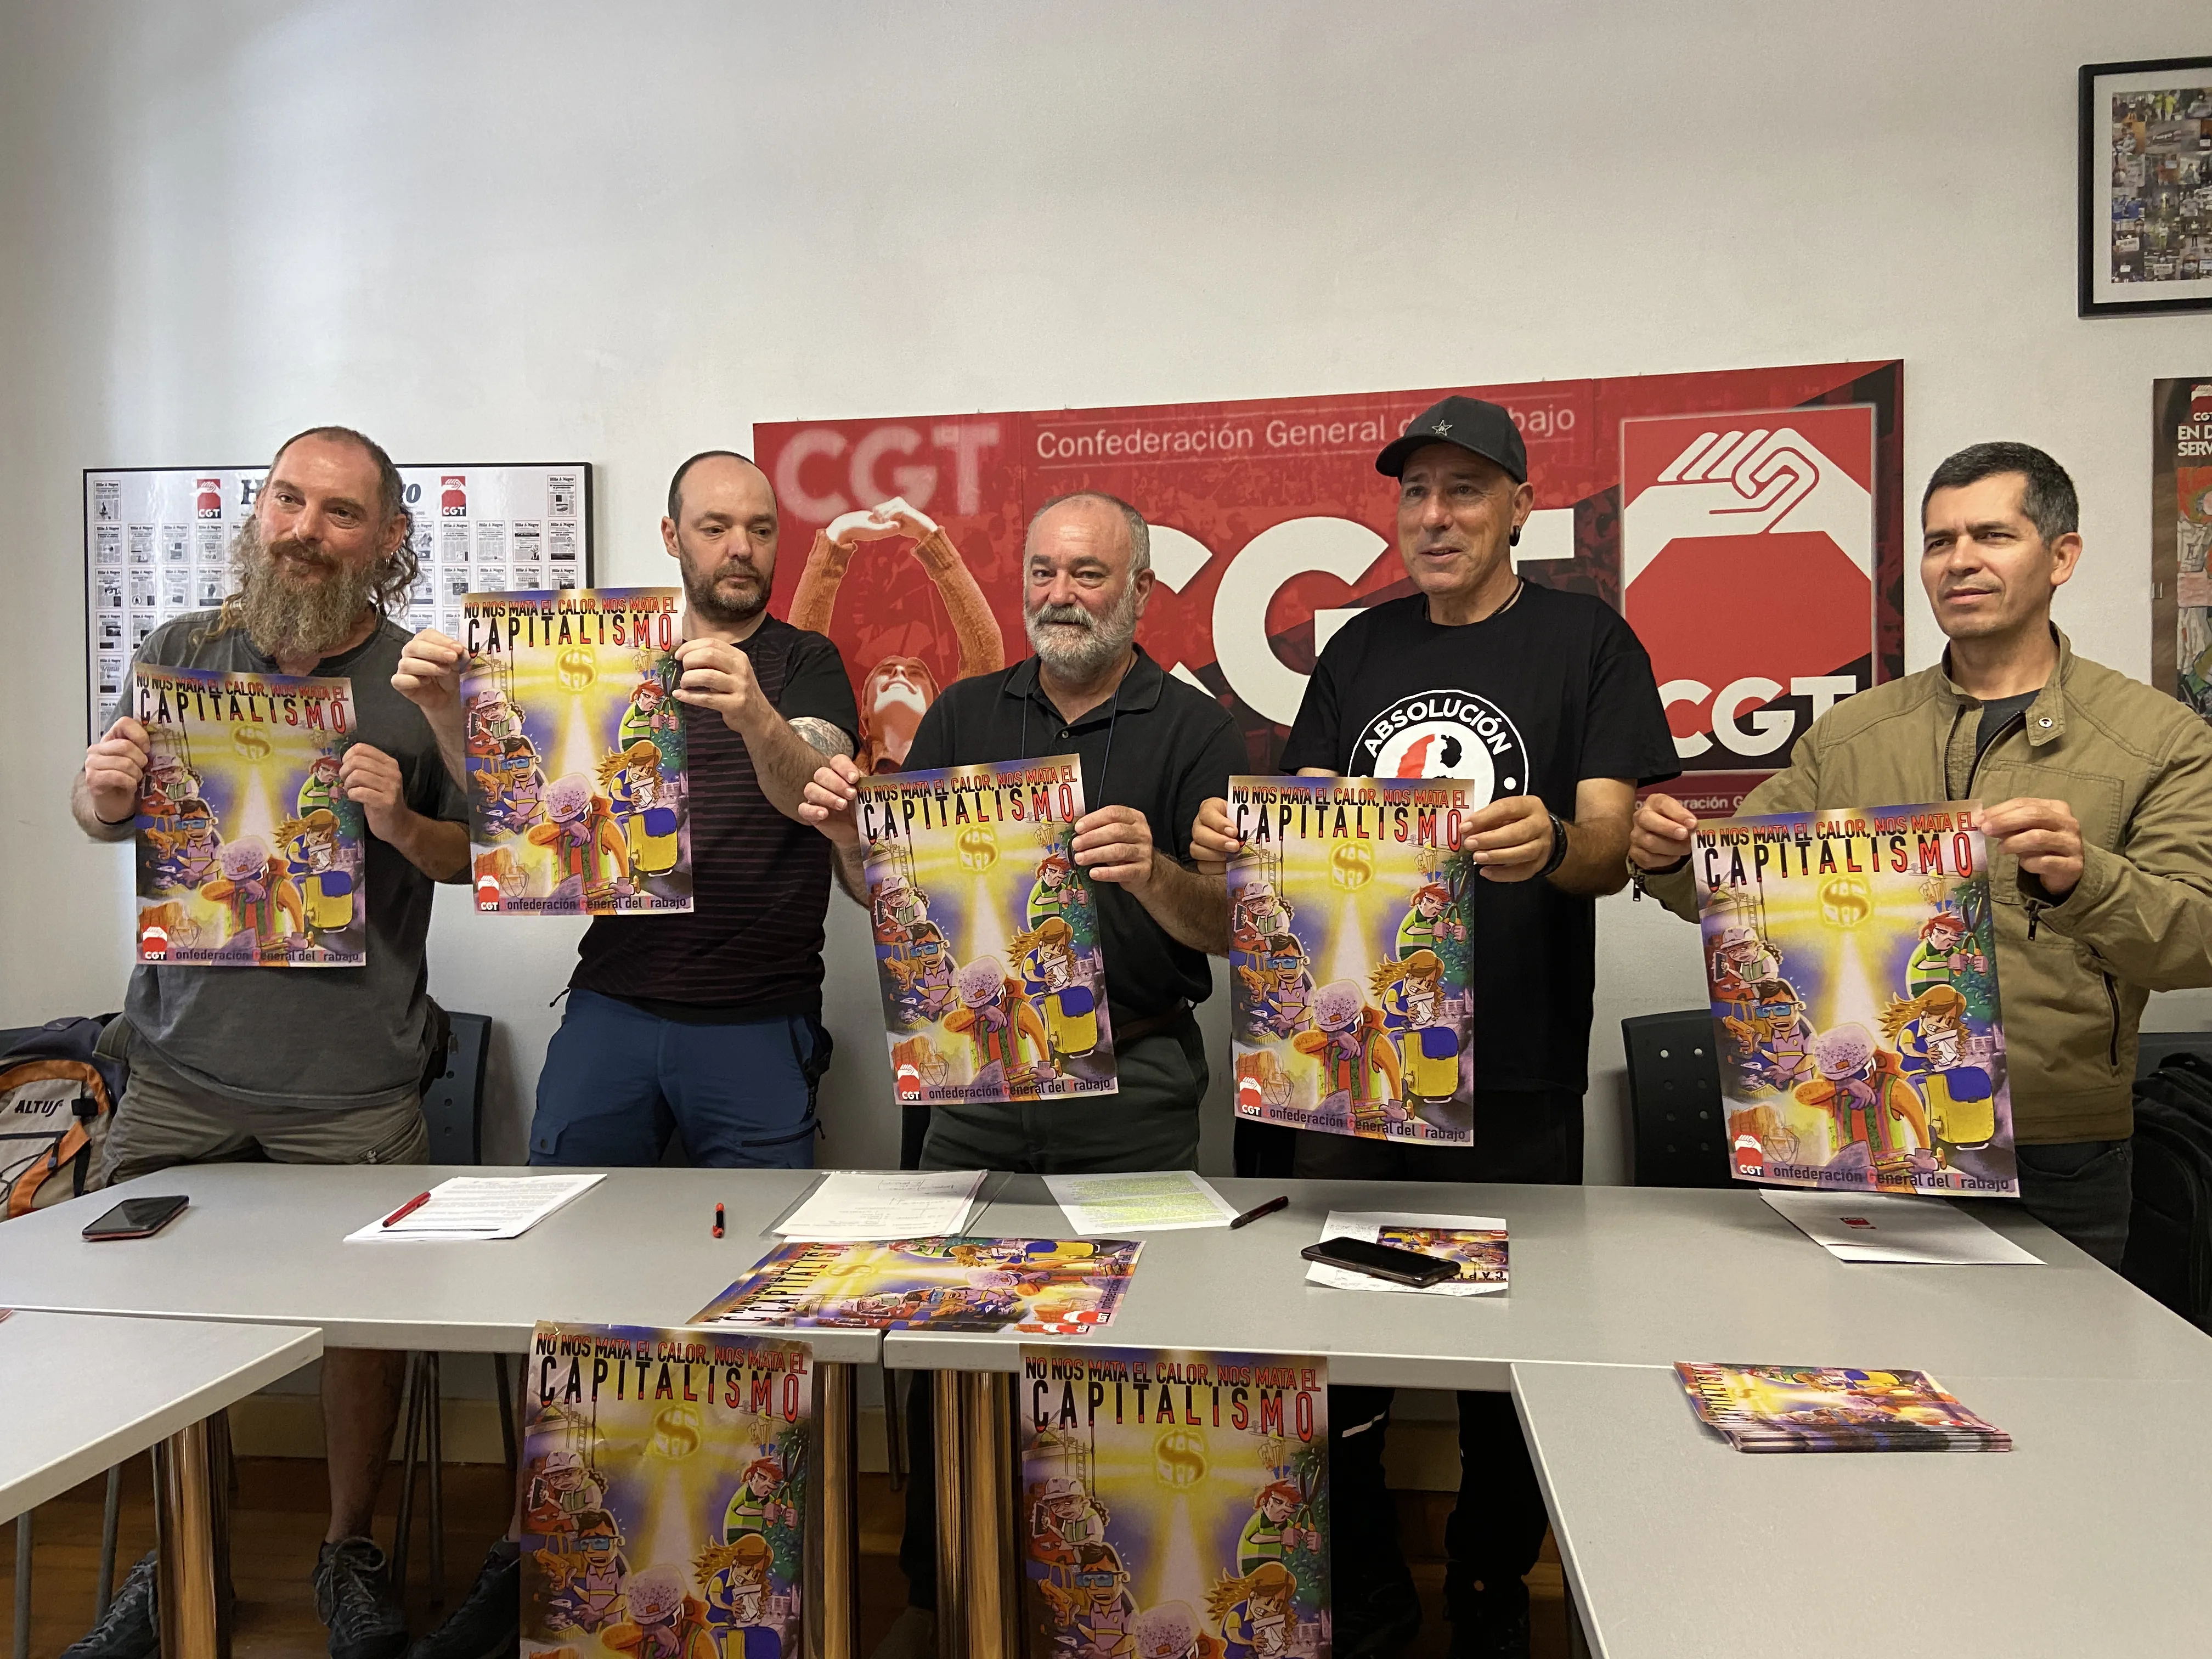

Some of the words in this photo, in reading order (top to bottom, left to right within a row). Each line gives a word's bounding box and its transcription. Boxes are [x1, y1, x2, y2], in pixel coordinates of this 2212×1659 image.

[1037, 422, 1254, 459] Confederación
[1266, 415, 1385, 447] General
[1508, 404, 1575, 437] bajo
[2178, 425, 2199, 440] EN
[775, 423, 1000, 522] CGT
[199, 509, 219, 518] CGT
[443, 506, 465, 515] CGT
[465, 603, 479, 618] NO
[482, 601, 505, 618] NOS
[509, 601, 537, 617] MATA
[541, 600, 555, 616] EL
[558, 599, 599, 616] CALOR,
[602, 598, 626, 614] NOS
[629, 597, 660, 613] MATA
[662, 597, 678, 613] EL
[468, 613, 672, 658] CAPITALISMO
[137, 673, 149, 688] NO
[152, 674, 173, 690] NOS
[176, 677, 205, 693] MATA
[208, 679, 223, 694] EL
[225, 681, 268, 698] CALOR,
[271, 684, 297, 698] NOS
[299, 686, 331, 701] MATA
[332, 687, 348, 701] EL
[140, 689, 347, 734] CAPITALISMO
[1658, 675, 1857, 758] CGT
[1364, 698, 1512, 758] ABSOLUCIÓN
[857, 787, 871, 804] NO
[875, 785, 898, 802] NOS
[900, 781, 932, 799] MATA
[934, 778, 949, 796] EL
[951, 774, 995, 794] CALOR,
[996, 771, 1022, 789] NOS
[1026, 768, 1059, 786] MATA
[1062, 765, 1077, 782] EL
[1233, 786, 1249, 804] NO
[1252, 786, 1277, 804] NOS
[1280, 787, 1312, 805] MATA
[1316, 788, 1330, 805] EL
[1334, 788, 1379, 808] CALOR,
[1384, 789, 1410, 807] NOS
[1414, 789, 1449, 809] MATA
[1452, 790, 1469, 809] EL
[864, 783, 1074, 844] CAPITALISMO
[1237, 804, 1462, 853] CAPITALISMO
[1696, 830, 1716, 849] NO
[1720, 827, 1749, 847] NOS
[1753, 825, 1791, 844] MATA
[1795, 822, 1813, 842] EL
[1816, 819, 1870, 840] CALOR,
[1874, 817, 1907, 836] NOS
[1911, 813, 1954, 834] MATA
[1957, 811, 1976, 832] EL
[1705, 832, 1972, 893] CAPITALISMO
[625, 897, 641, 907] del
[145, 952, 165, 960] CGT
[298, 949, 315, 961] del
[902, 1092, 919, 1100] CGT
[1048, 1080, 1065, 1093] del
[15, 1099, 64, 1117] ALTUS
[1242, 1104, 1261, 1116] CGT
[1397, 1121, 1415, 1137] del
[1740, 1164, 1763, 1176] CGT
[1927, 1170, 1950, 1188] del
[536, 1332, 556, 1355] NO
[561, 1334, 591, 1357] NOS
[595, 1336, 632, 1359] MATA
[636, 1340, 653, 1362] EL
[658, 1341, 709, 1367] CALOR,
[714, 1345, 744, 1368] NOS
[748, 1349, 786, 1373] MATA
[789, 1351, 808, 1375] EL
[1025, 1357, 1047, 1380] NO
[1052, 1358, 1084, 1381] NOS
[1088, 1359, 1128, 1383] MATA
[1133, 1361, 1152, 1384] EL
[1155, 1362, 1213, 1389] CALOR,
[1218, 1364, 1251, 1389] NOS
[1255, 1367, 1297, 1391] MATA
[1301, 1369, 1321, 1392] EL
[540, 1356, 800, 1424] CAPITALISMO
[1033, 1380, 1313, 1443] CAPITALISMO
